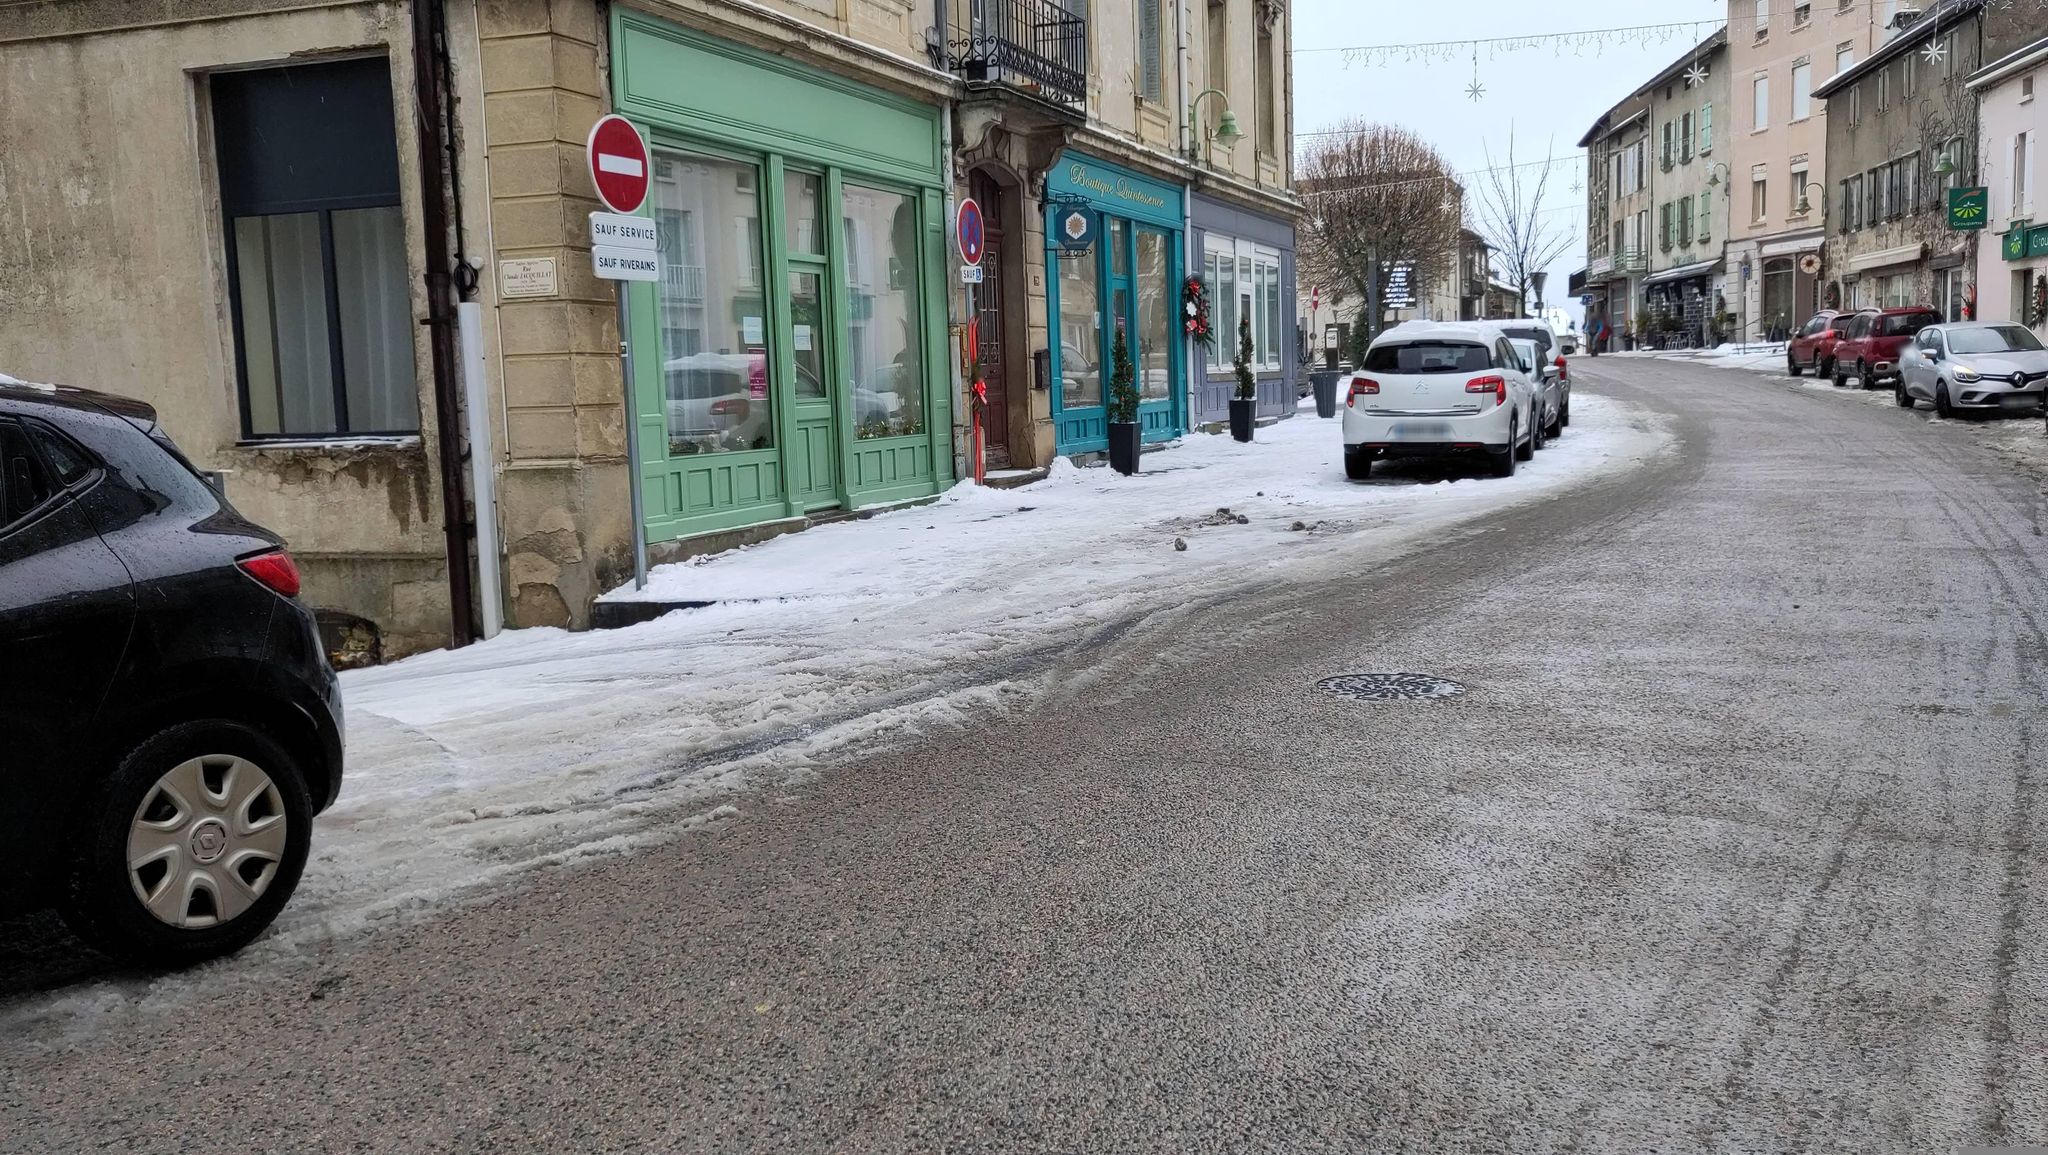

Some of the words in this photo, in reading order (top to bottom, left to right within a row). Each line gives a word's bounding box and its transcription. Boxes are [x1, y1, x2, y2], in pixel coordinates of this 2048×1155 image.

[1070, 164, 1114, 198] Boutique
[1116, 177, 1165, 208] Quintessence
[595, 223, 617, 236] SAUF
[620, 226, 655, 240] SERVICE
[598, 256, 617, 268] SAUF
[620, 258, 656, 272] RIVERAINS
[963, 269, 976, 280] SAUF
